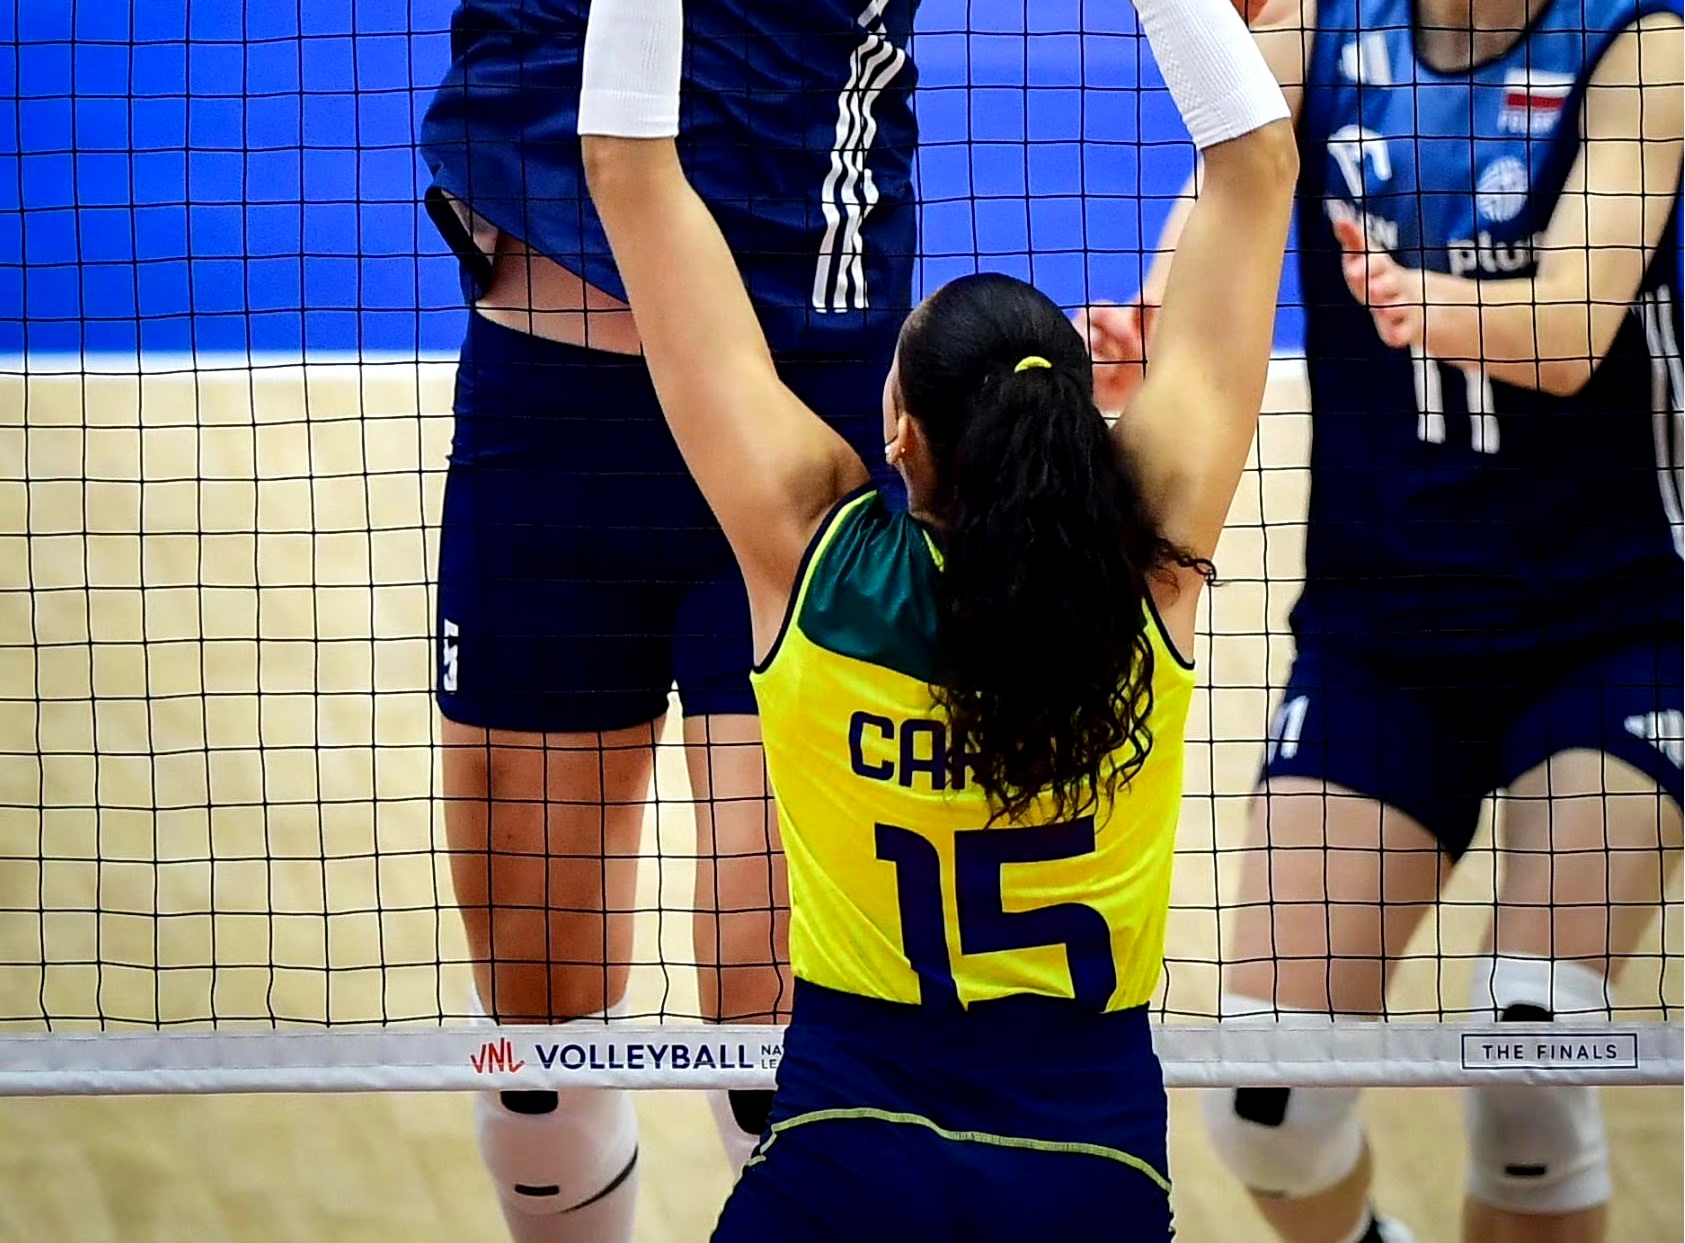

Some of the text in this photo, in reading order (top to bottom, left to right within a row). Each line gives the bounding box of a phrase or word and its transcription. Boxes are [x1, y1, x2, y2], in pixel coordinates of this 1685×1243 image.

[874, 815, 1117, 1014] 15
[470, 1037, 754, 1074] VNL VOLLEYBALL
[1482, 1044, 1618, 1060] THE FINALS
